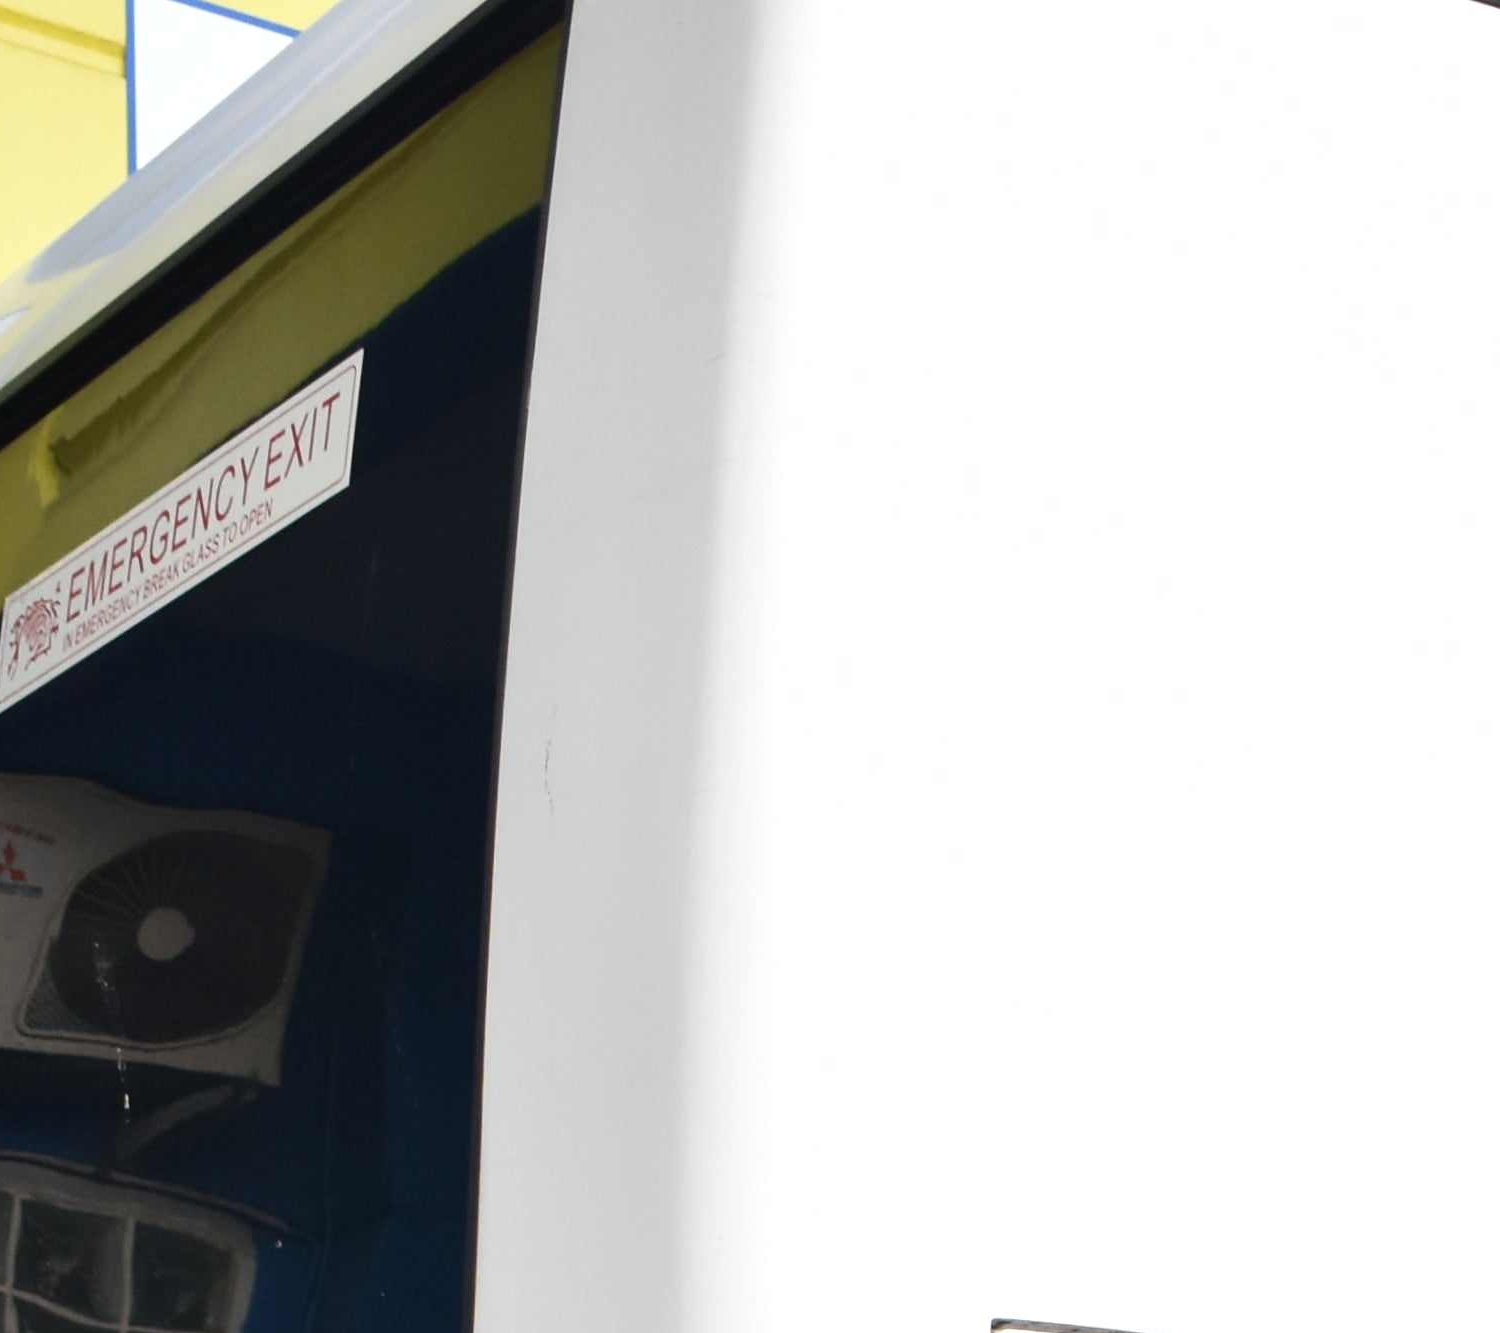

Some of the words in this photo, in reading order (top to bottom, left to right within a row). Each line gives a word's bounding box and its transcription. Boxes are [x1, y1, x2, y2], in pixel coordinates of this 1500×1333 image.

[63, 632, 73, 651] IN
[75, 589, 142, 645] EMERGENCY
[143, 566, 180, 600] BREAK
[182, 533, 220, 574] GLASS
[222, 522, 238, 548] TO
[239, 498, 274, 536] OPEN
[66, 447, 260, 624] EMERGENCY
[264, 392, 341, 491] EXIT
